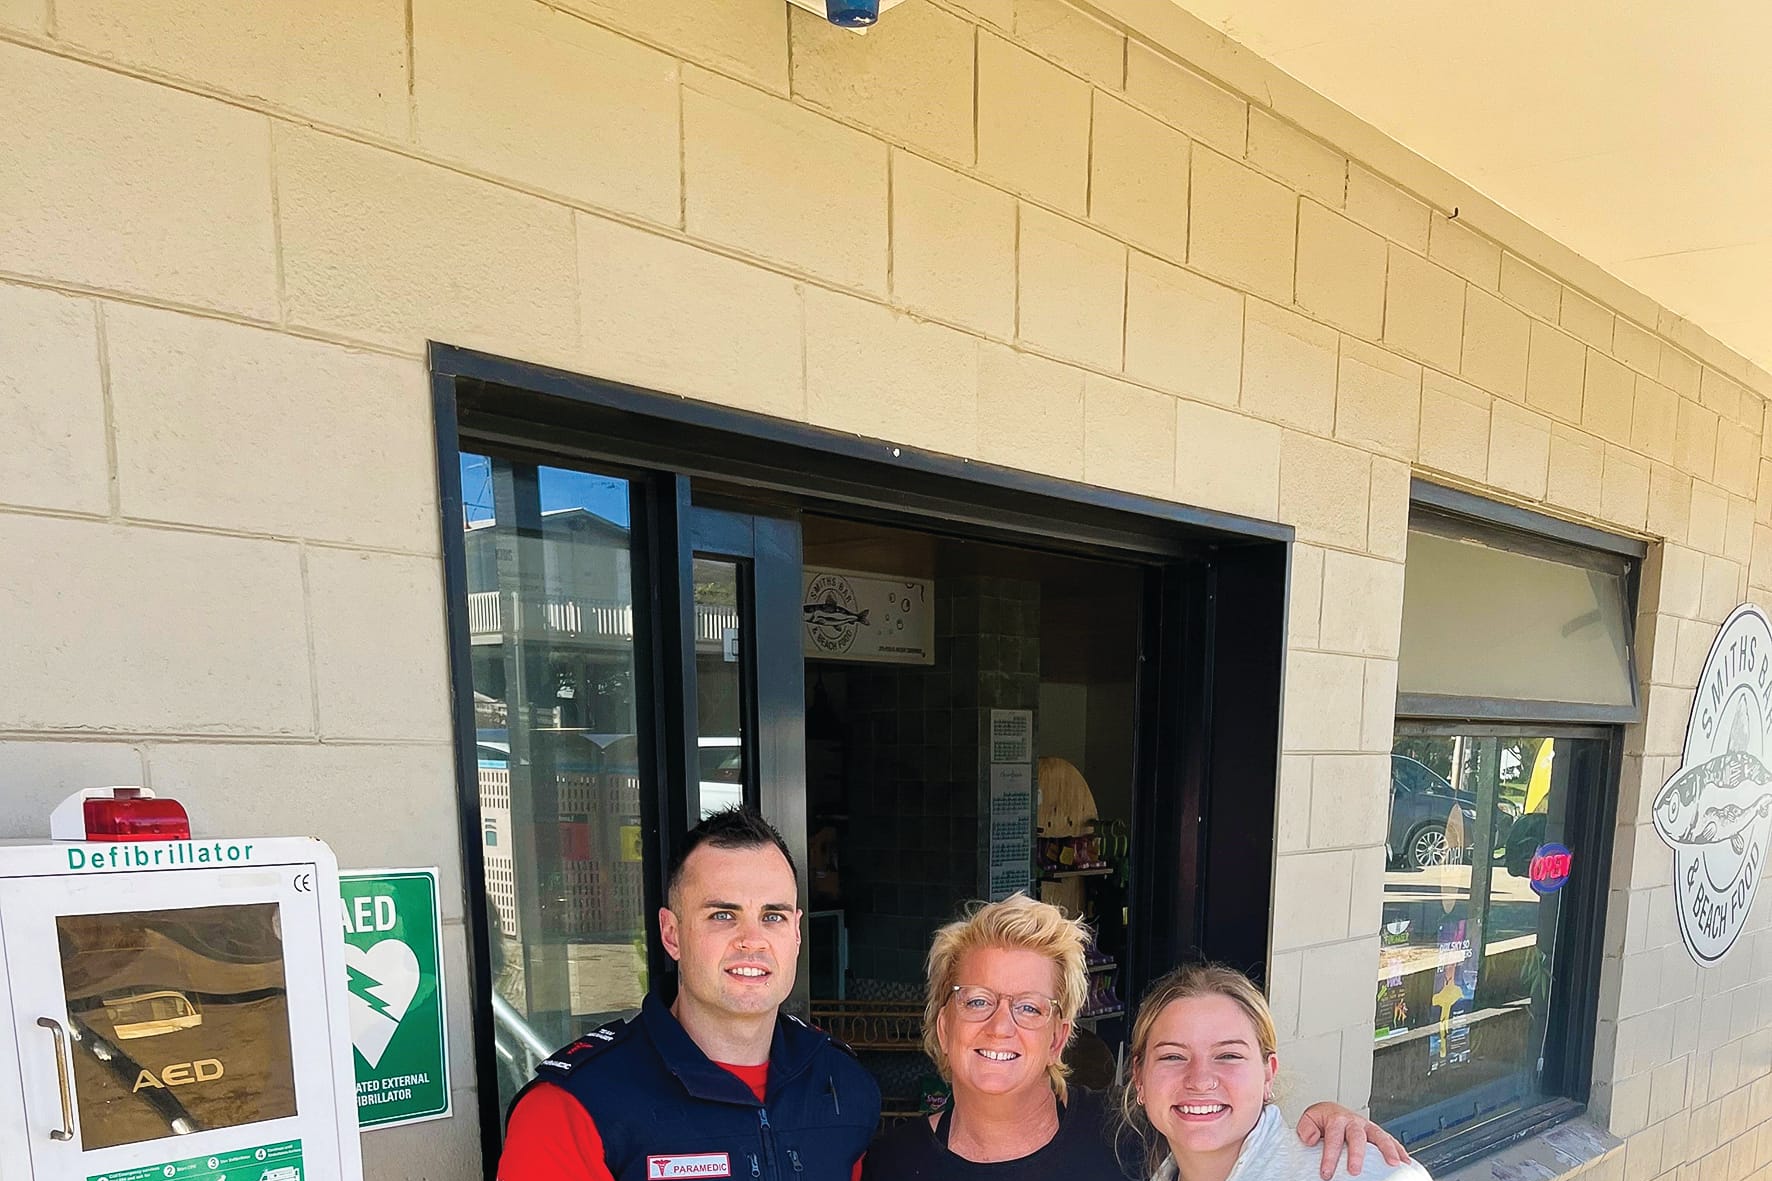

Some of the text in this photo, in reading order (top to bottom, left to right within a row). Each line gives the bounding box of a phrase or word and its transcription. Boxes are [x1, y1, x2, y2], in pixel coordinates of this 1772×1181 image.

[1702, 634, 1757, 739] SMITHS
[67, 842, 253, 870] Defibrillator
[1533, 854, 1572, 881] OPEN
[1693, 888, 1727, 940] BEACH
[1730, 841, 1760, 924] FOOD
[340, 895, 397, 934] AED
[132, 1058, 224, 1093] AED
[382, 1073, 430, 1089] EXTERNAL
[358, 1089, 412, 1107] IBRILLATOR
[673, 1162, 728, 1175] PARAMEDIC
